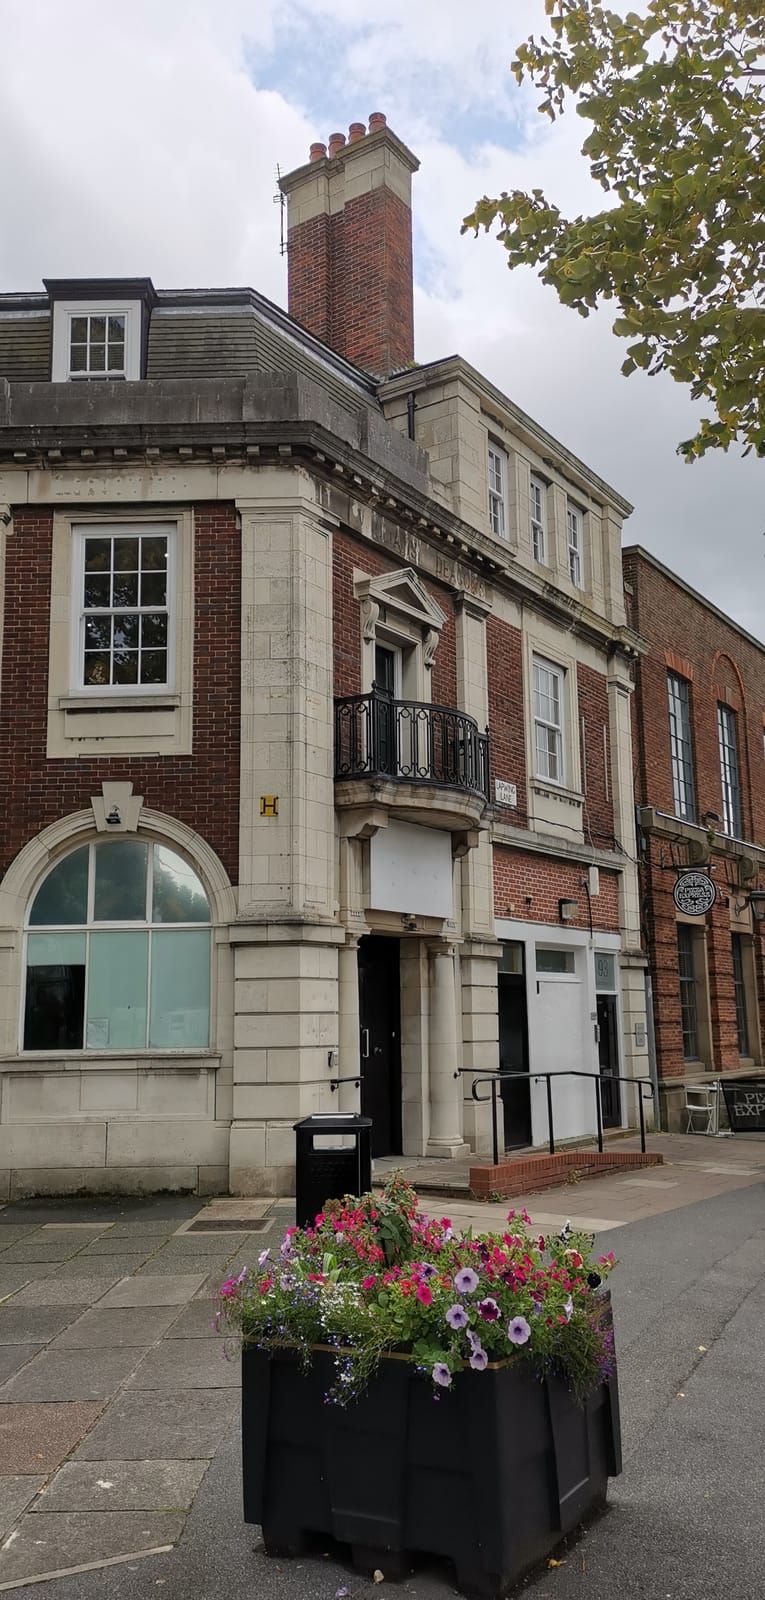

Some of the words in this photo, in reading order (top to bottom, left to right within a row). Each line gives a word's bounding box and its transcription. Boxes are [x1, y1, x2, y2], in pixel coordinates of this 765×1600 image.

[263, 798, 276, 814] H
[679, 891, 711, 899] EXPRESS
[598, 959, 609, 977] 93
